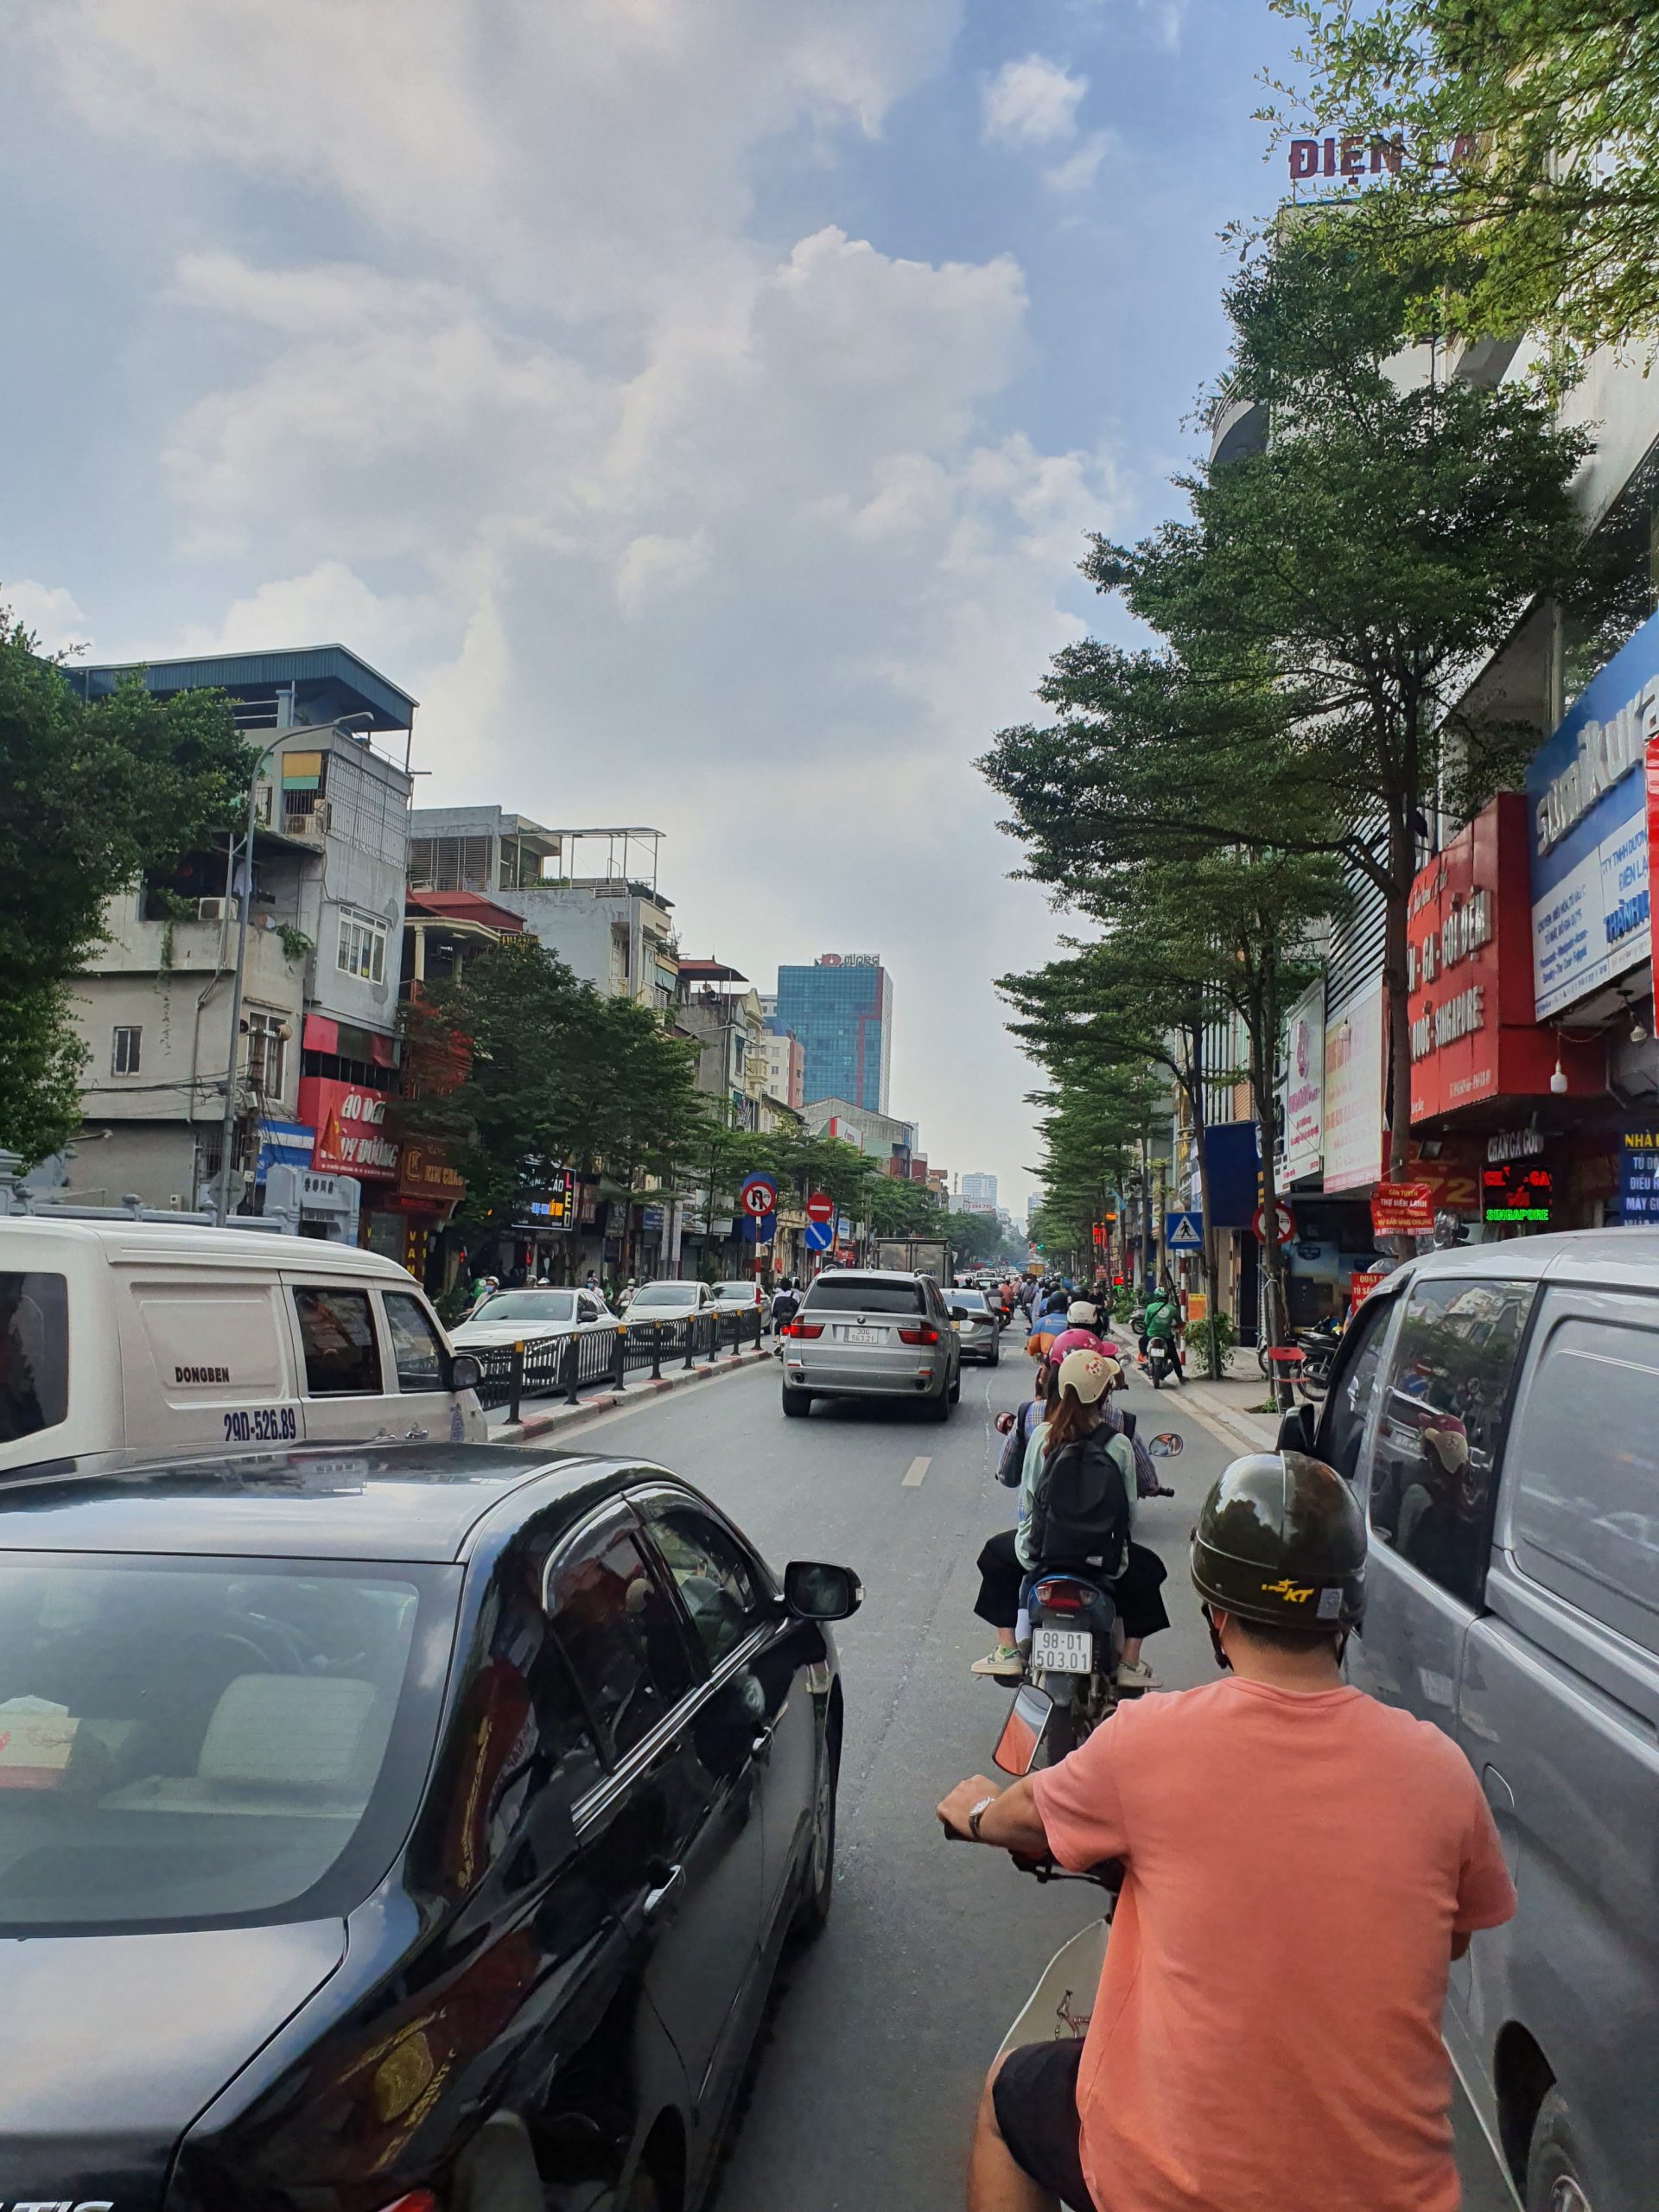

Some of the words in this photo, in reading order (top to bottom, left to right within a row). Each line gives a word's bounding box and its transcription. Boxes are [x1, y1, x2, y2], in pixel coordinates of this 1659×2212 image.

[1434, 985, 1481, 1049] SINGAPORE
[340, 1086, 361, 1120] ÁO
[1624, 1129, 1652, 1147] NHÀ
[1485, 1209, 1549, 1221] SINGAPORE
[175, 1366, 230, 1382] DONGBEN
[224, 1408, 297, 1442] 29D-526.89
[1042, 1631, 1083, 1651] 98-D1
[1036, 1650, 1088, 1670] 503.01
